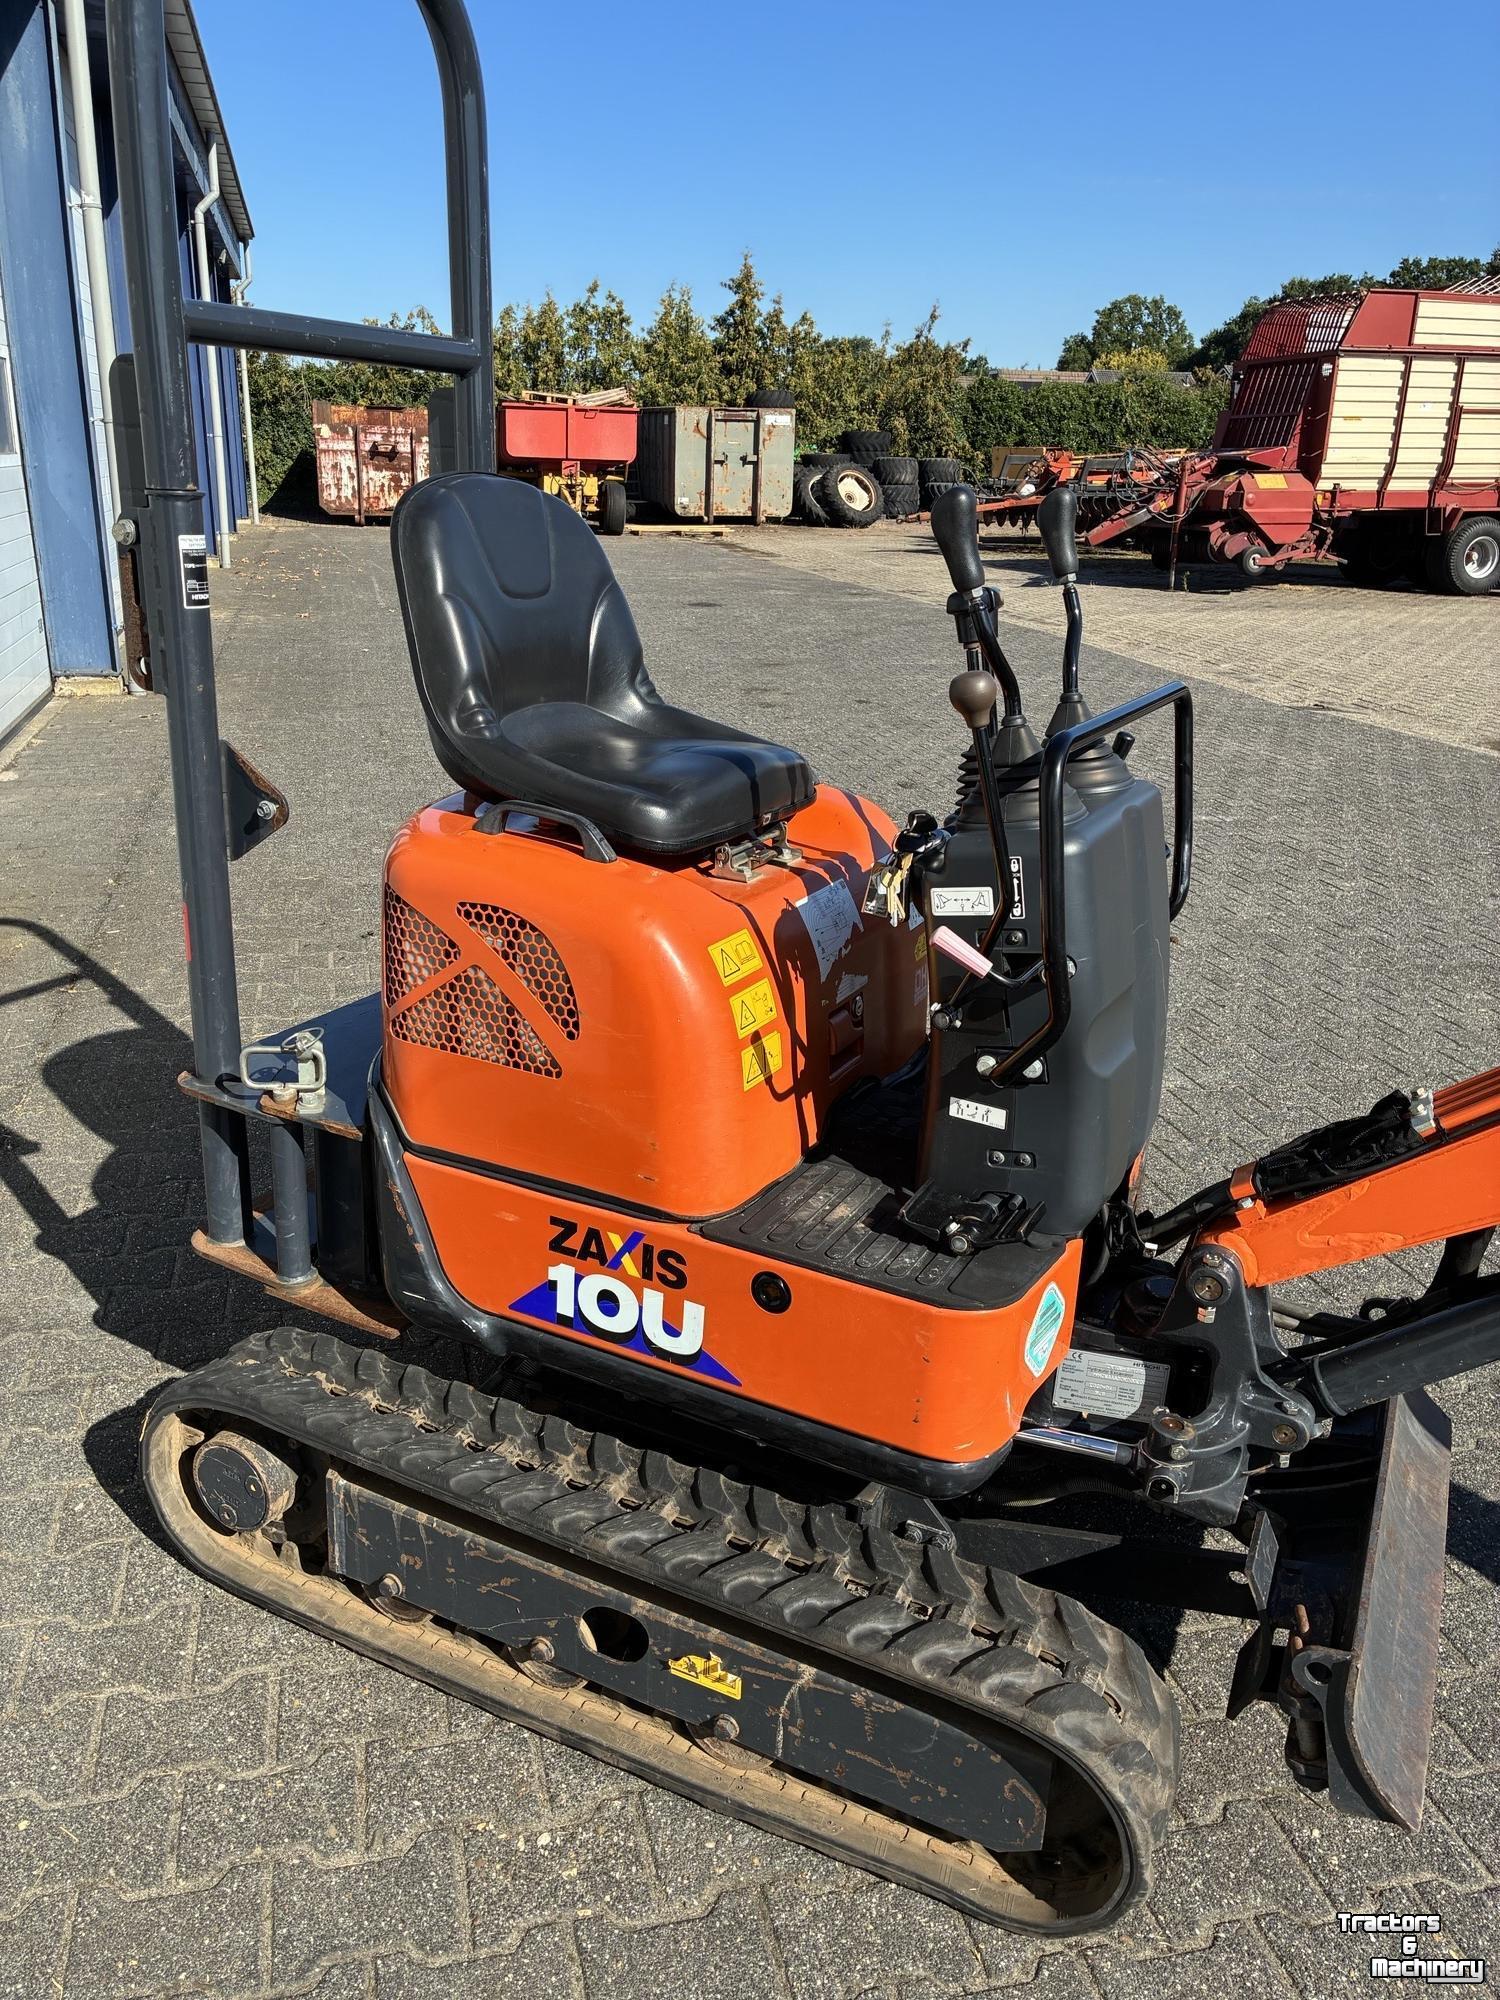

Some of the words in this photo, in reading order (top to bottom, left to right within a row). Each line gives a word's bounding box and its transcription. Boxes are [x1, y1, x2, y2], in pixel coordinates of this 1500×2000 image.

[549, 1215, 688, 1290] ZAXIS
[547, 1263, 706, 1366] 10U
[1133, 1362, 1161, 1370] HITACHI
